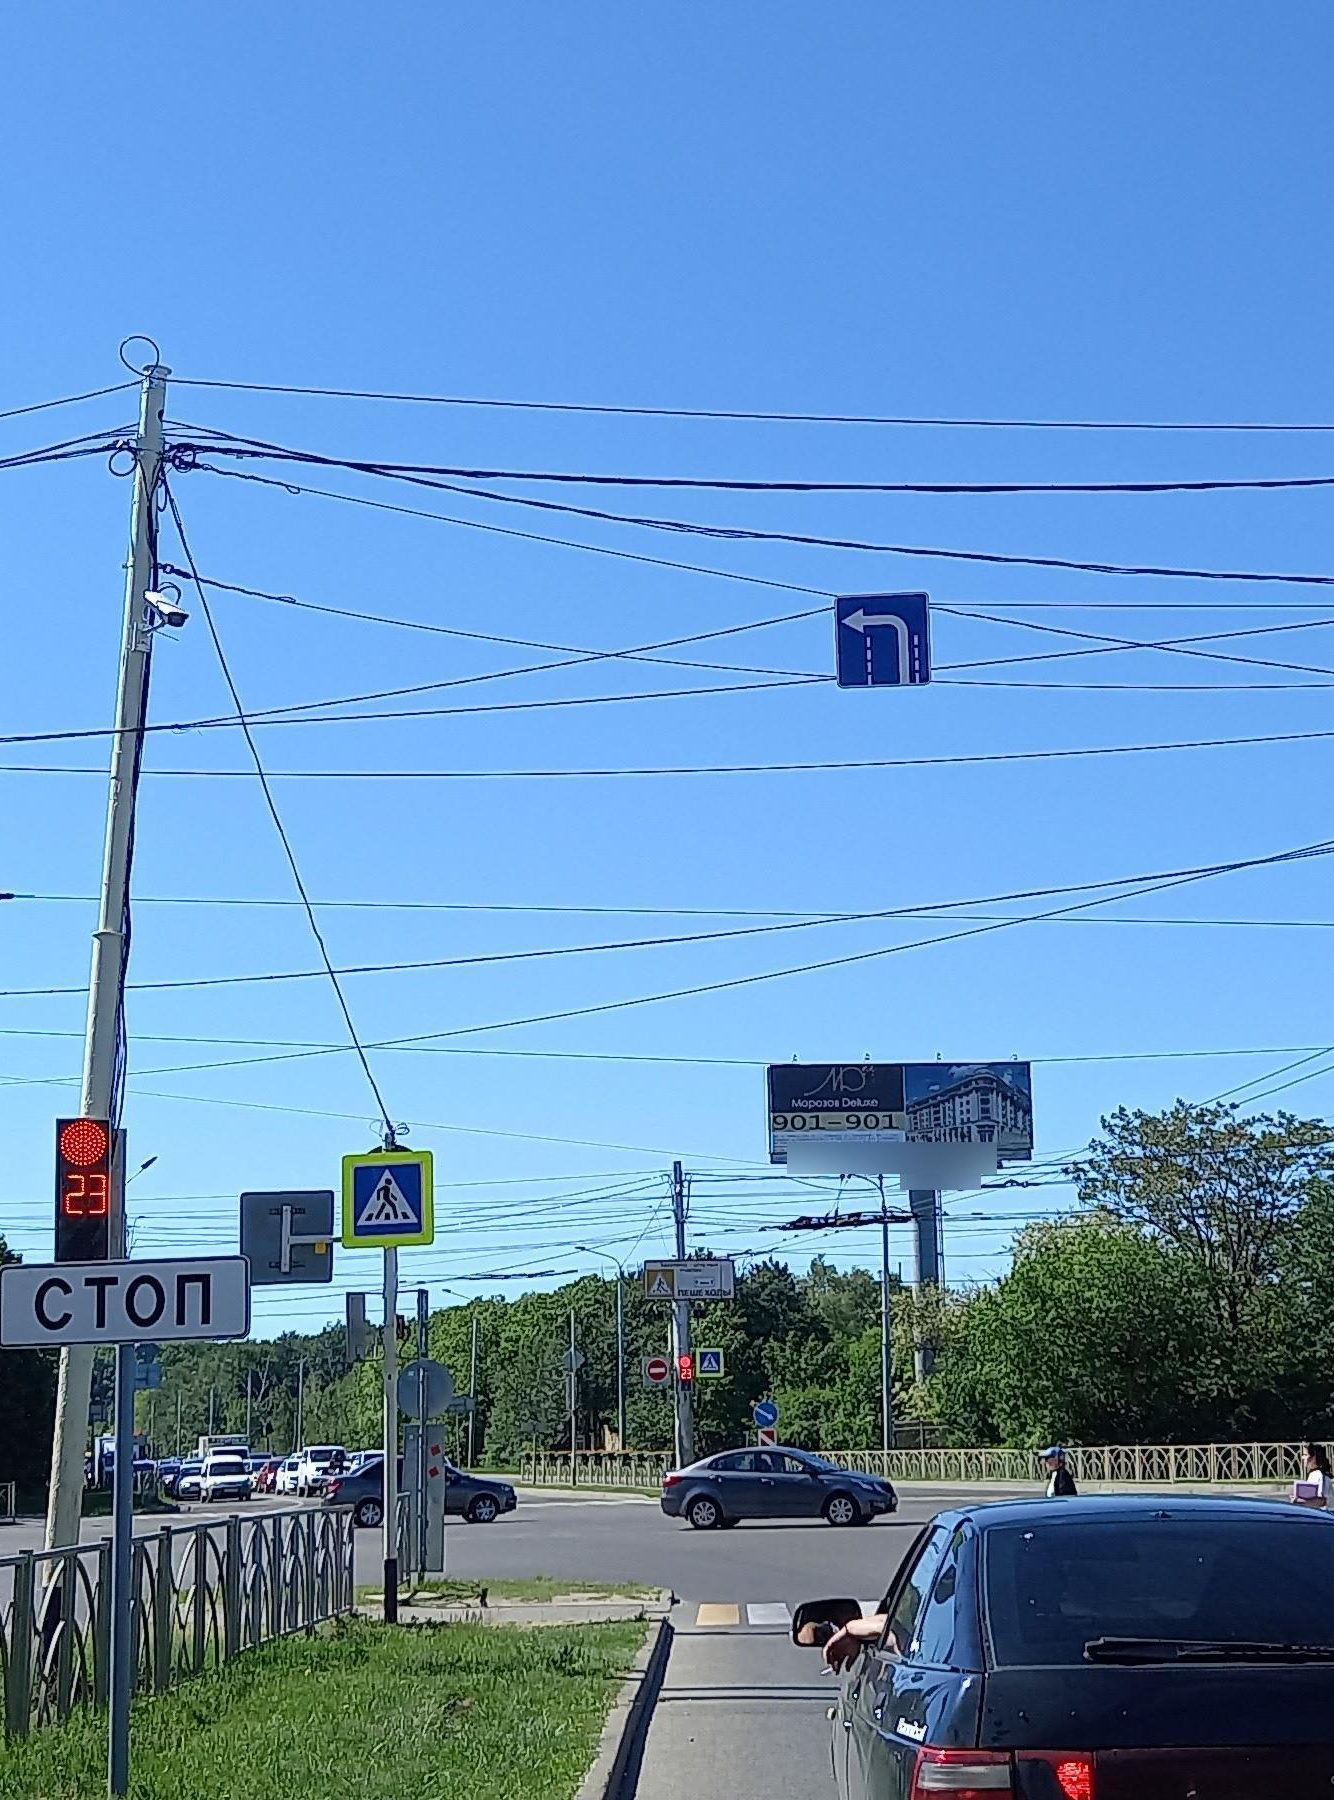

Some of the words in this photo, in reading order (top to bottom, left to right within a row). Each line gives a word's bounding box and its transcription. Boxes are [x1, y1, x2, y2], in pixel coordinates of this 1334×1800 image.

[842, 1097, 879, 1108] Deluxe
[773, 1114, 899, 1131] 901-901
[65, 1174, 108, 1216] 23
[34, 1274, 212, 1331] СТОП
[681, 1368, 692, 1380] 23
